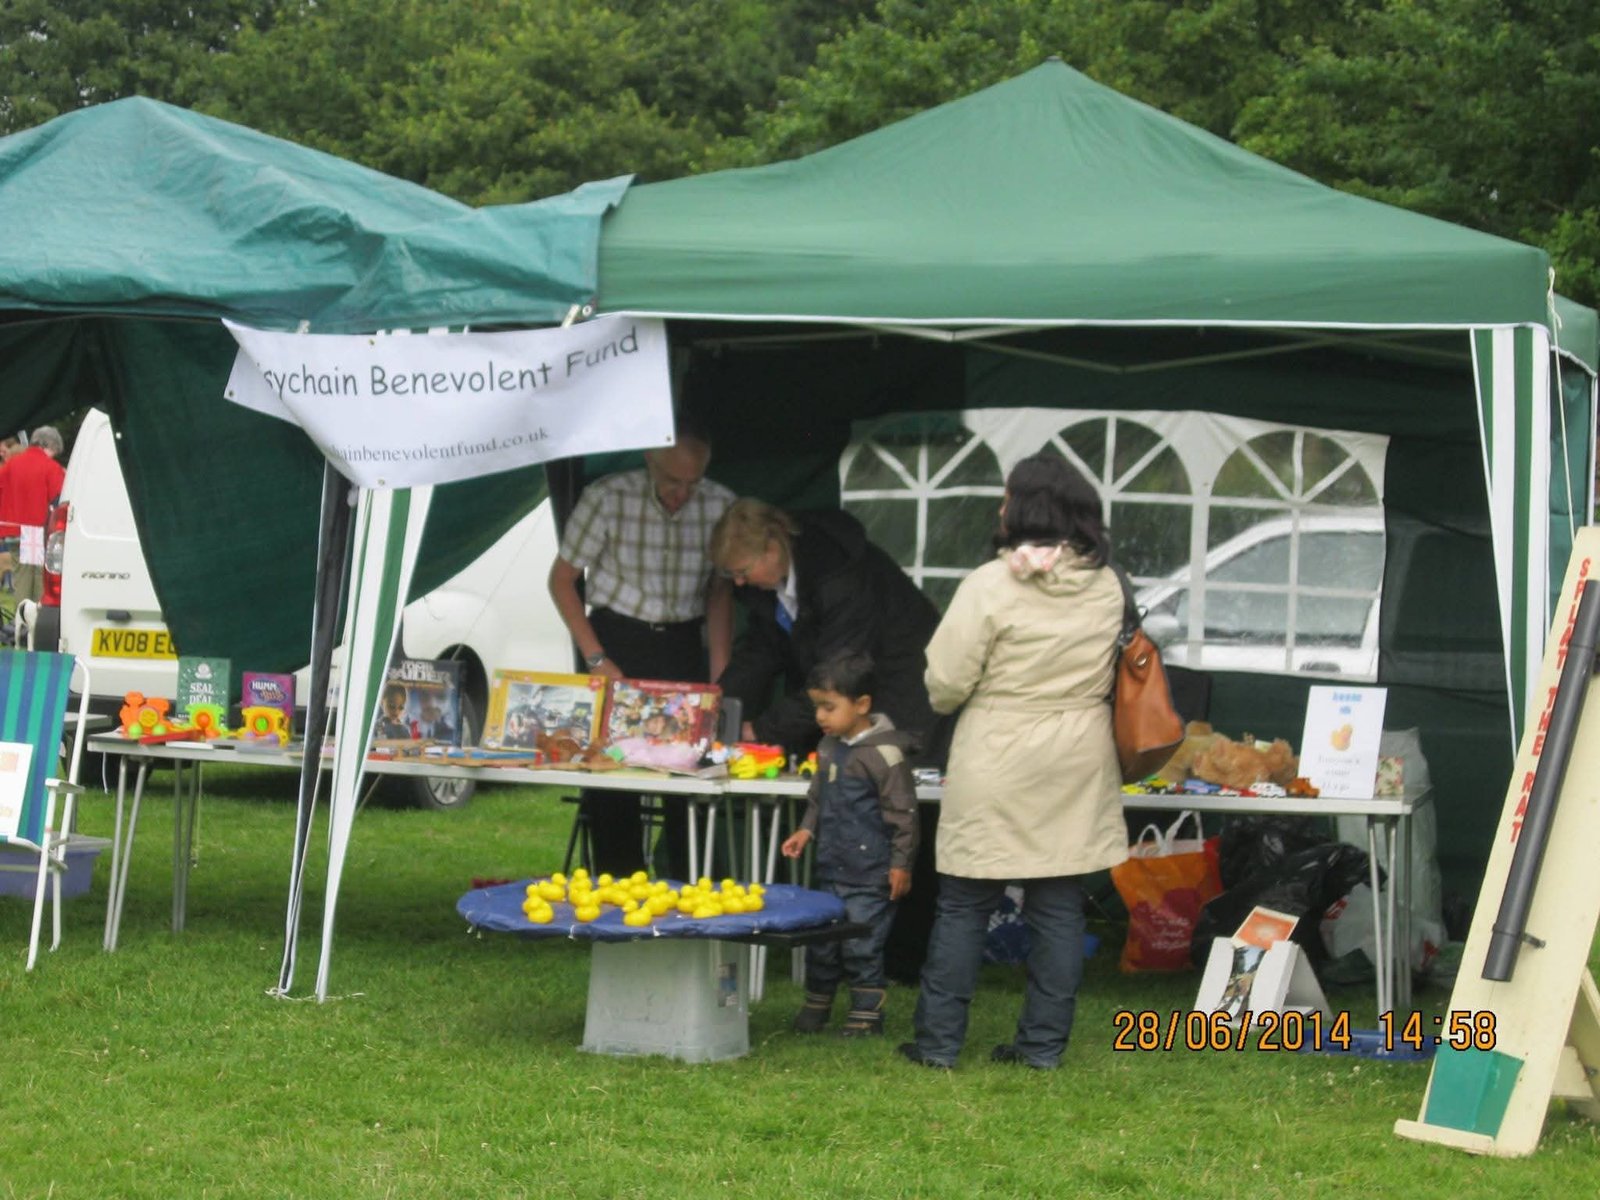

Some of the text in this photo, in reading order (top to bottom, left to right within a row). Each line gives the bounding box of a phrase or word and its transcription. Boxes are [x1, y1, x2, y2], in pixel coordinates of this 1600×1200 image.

[261, 325, 640, 400] sychain Benevolent Fund
[333, 426, 549, 463] hainbenevolentfund.co.uk
[98, 629, 149, 653] KV08
[1510, 557, 1591, 843] SPLAT THE RAT
